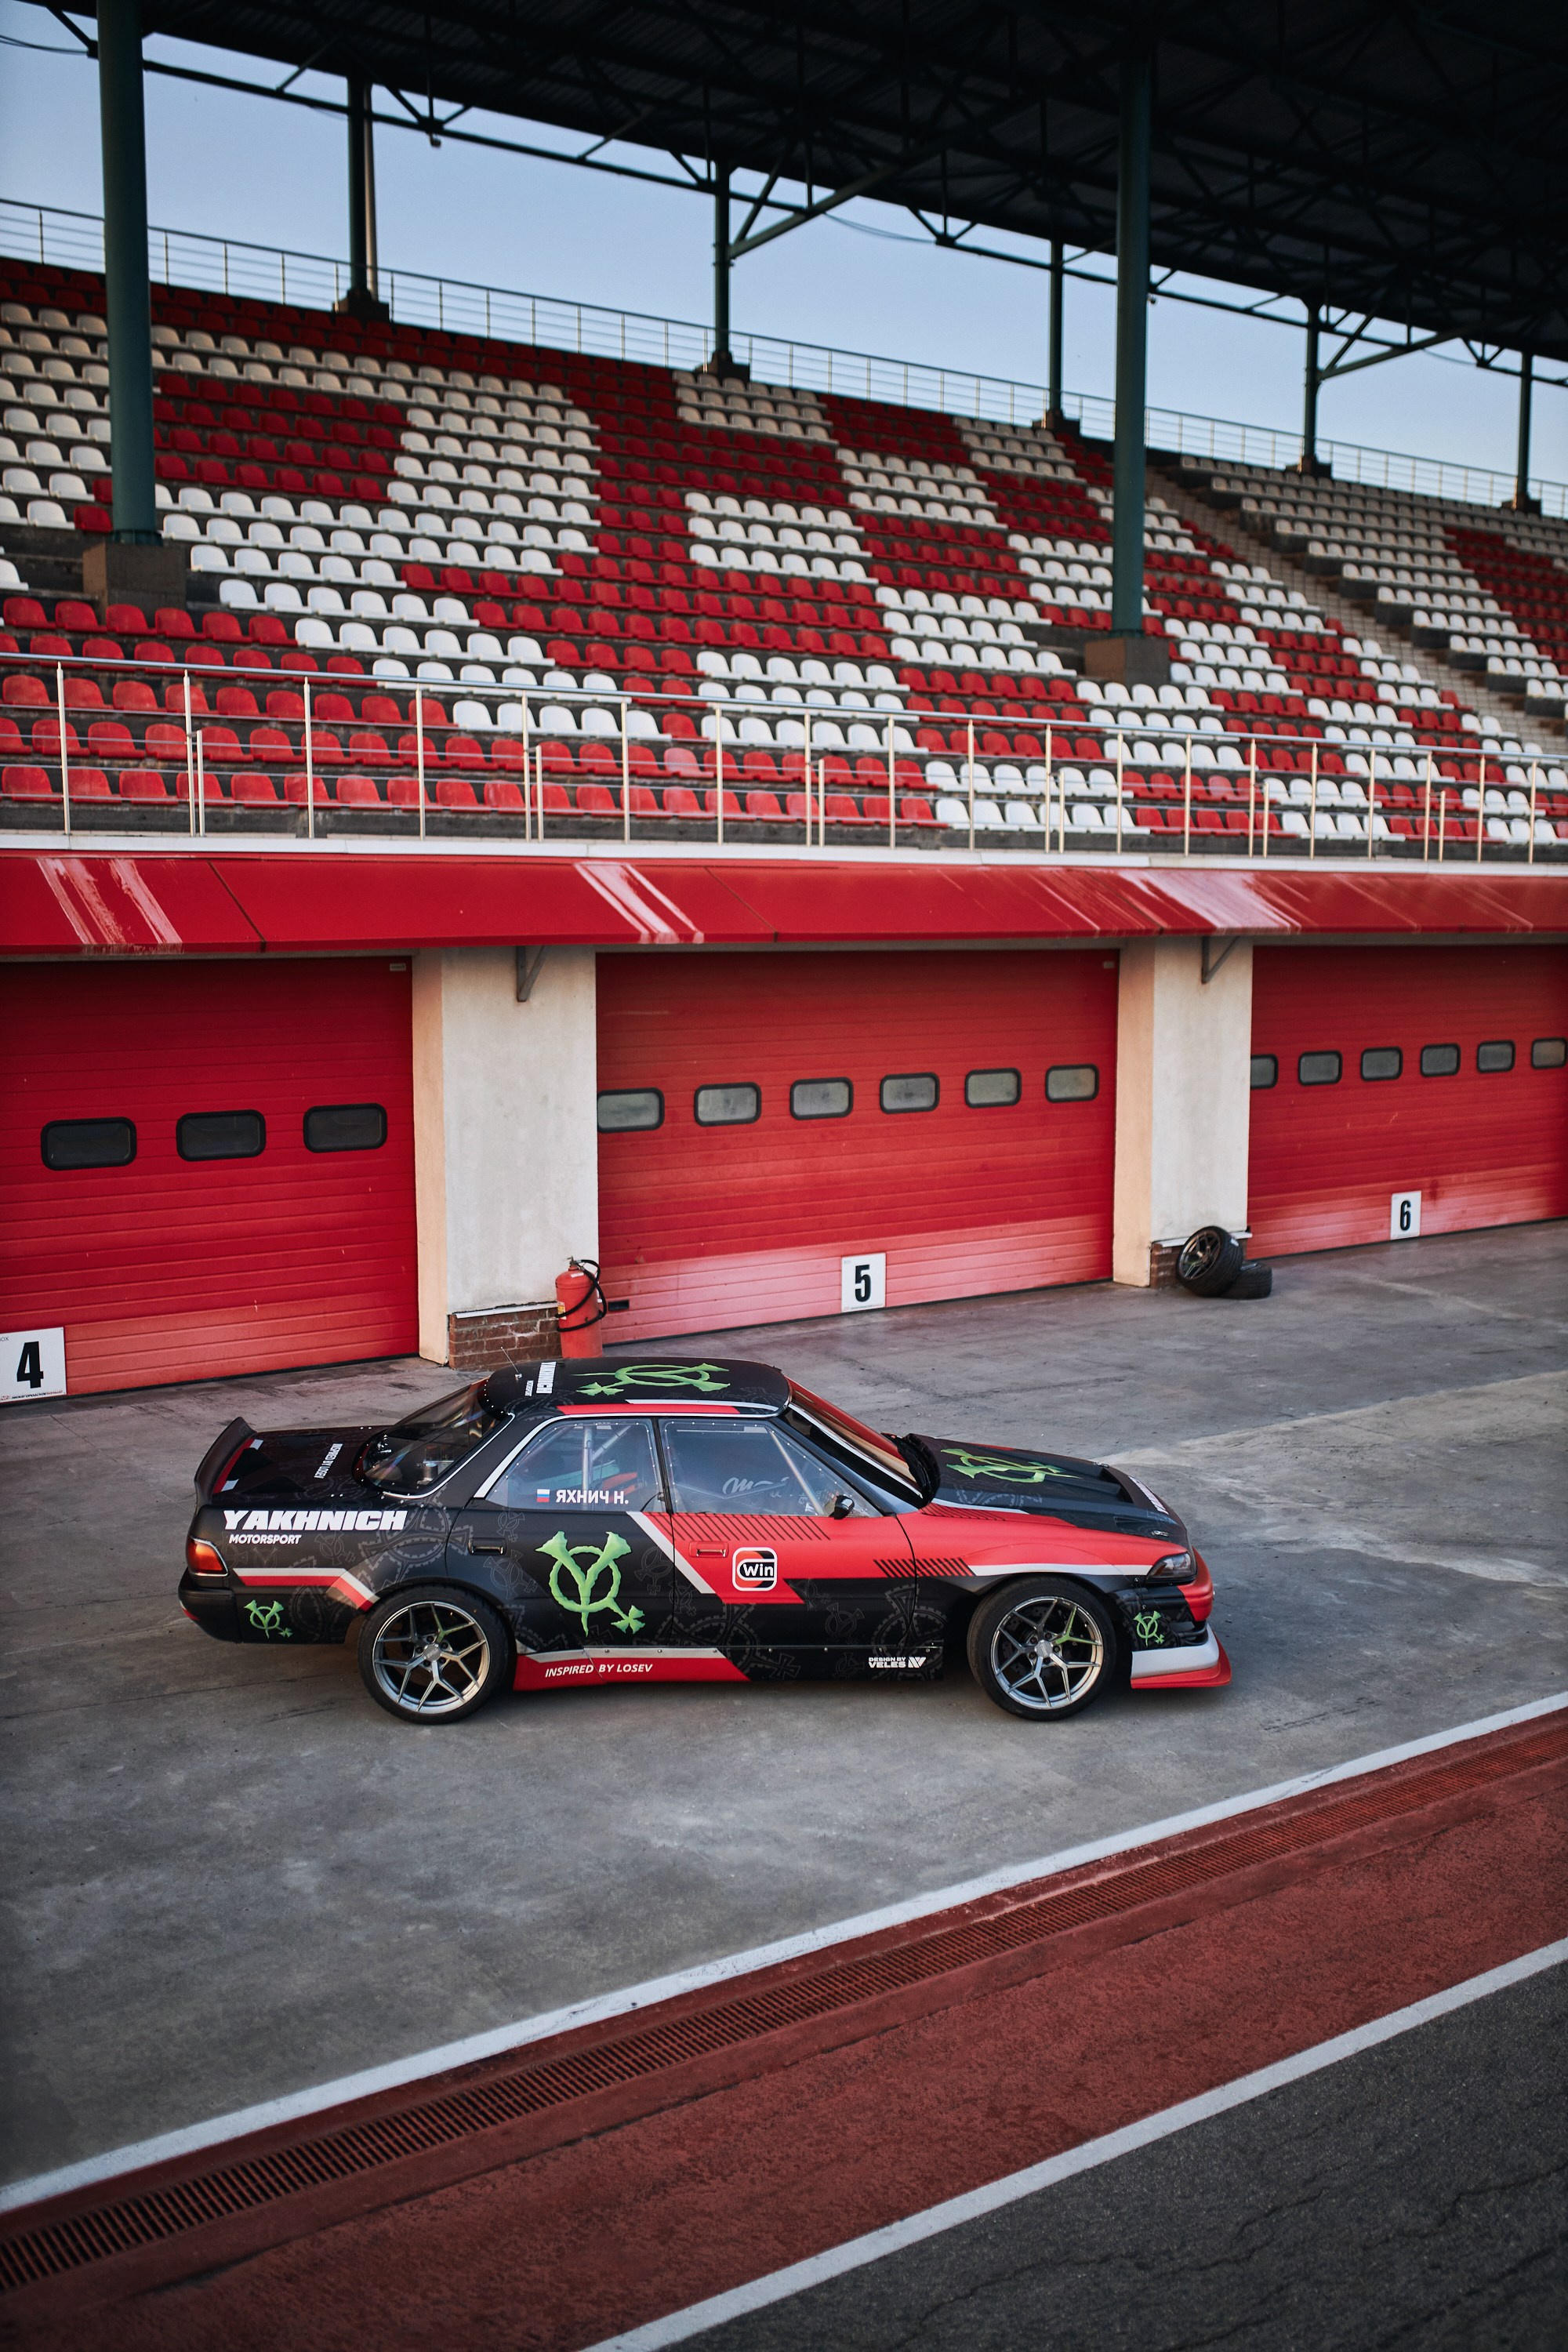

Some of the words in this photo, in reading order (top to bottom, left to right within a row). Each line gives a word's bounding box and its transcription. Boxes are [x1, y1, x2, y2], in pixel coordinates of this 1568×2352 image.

[1400, 1200, 1411, 1231] 6
[855, 1265, 871, 1302] 5
[16, 1341, 44, 1388] 4
[556, 1489, 609, 1504] ЯХНИЧ
[613, 1490, 630, 1504] Н.
[223, 1510, 408, 1531] YAKHNICH
[228, 1534, 302, 1544] MOTORSPORT
[742, 1563, 774, 1577] Win
[545, 1664, 594, 1678] INSPIRED
[598, 1664, 615, 1673] BY
[616, 1664, 653, 1673] LOSEV
